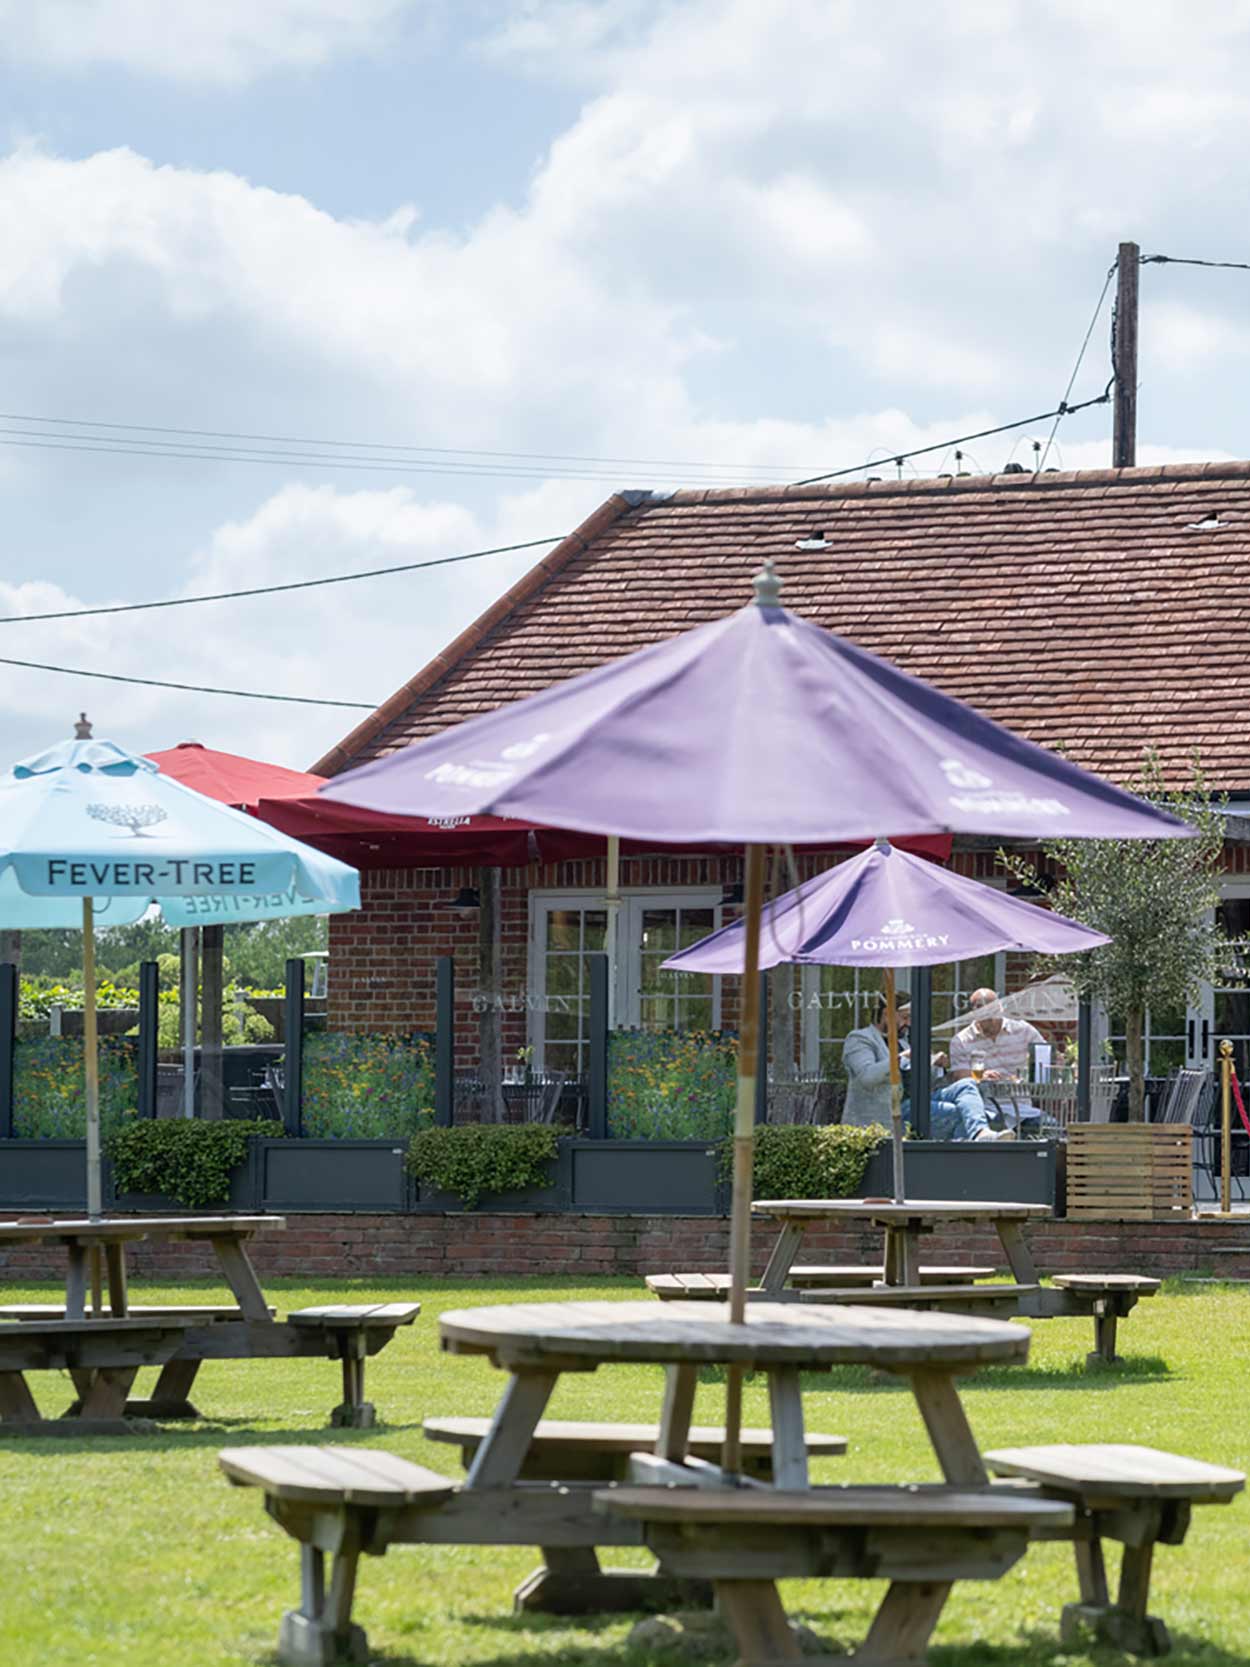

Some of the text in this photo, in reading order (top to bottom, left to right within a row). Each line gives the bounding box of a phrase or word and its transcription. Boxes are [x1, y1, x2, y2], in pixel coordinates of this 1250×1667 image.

[48, 860, 256, 886] FEVER-TREE
[851, 934, 950, 951] POMMERY
[787, 990, 890, 1009] GALVIN
